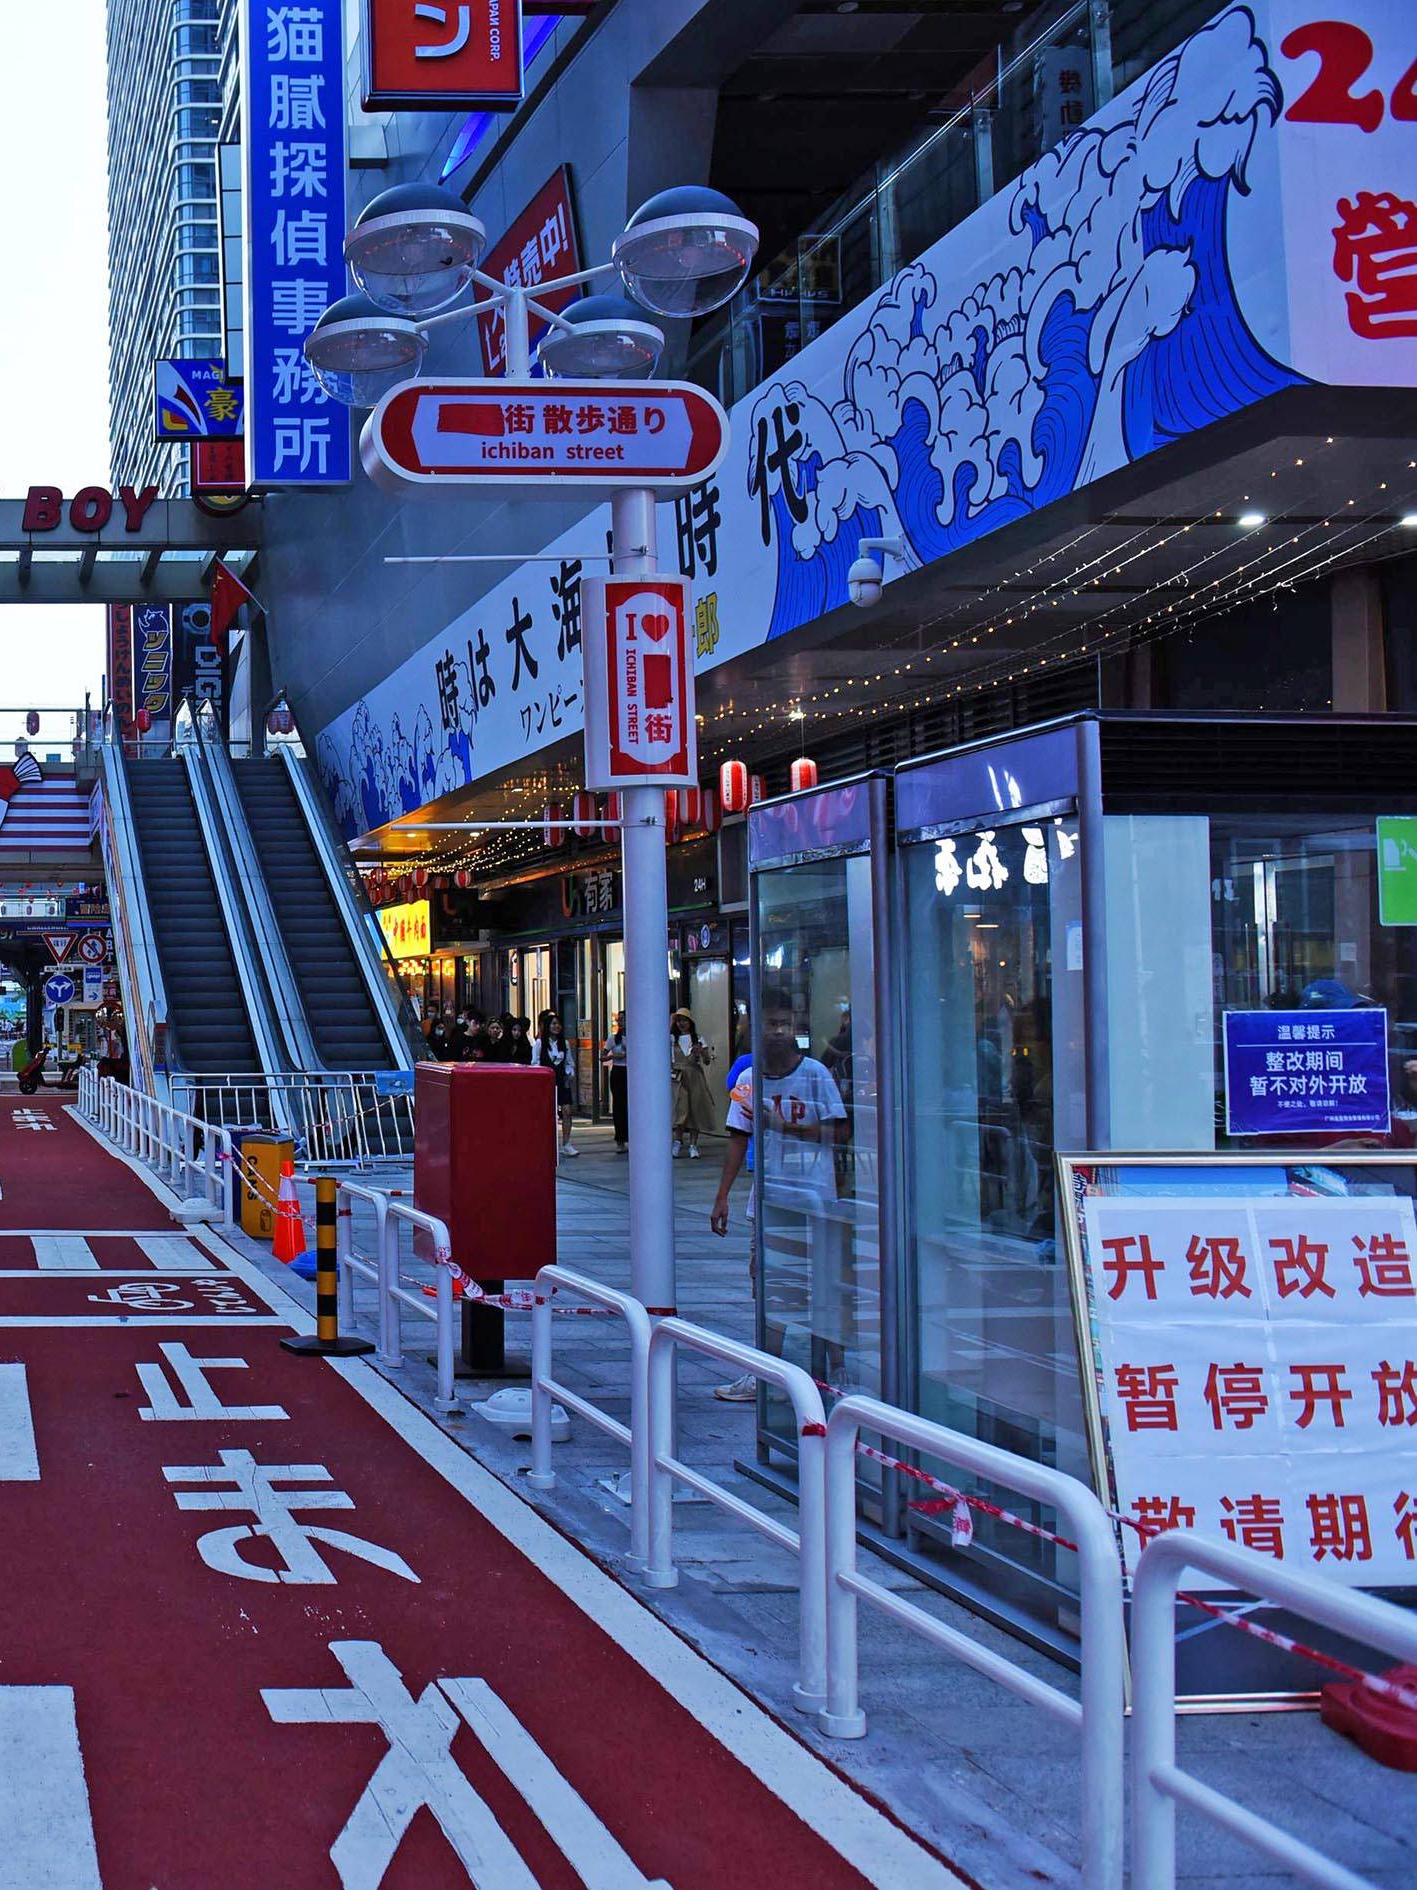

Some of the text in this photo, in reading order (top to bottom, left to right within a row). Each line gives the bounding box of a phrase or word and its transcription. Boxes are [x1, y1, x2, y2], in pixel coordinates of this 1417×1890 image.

[490, 28, 500, 61] CORP.
[1282, 21, 1417, 132] 2
[204, 387, 239, 421] 豪
[543, 404, 666, 435] 散歩通り
[482, 442, 624, 461] ichiban street
[22, 486, 160, 532] BOY
[434, 403, 809, 731] 時は大海時代
[625, 613, 636, 641] I
[519, 683, 585, 742] ワンピー
[626, 649, 639, 745] ICHIBAN STREET
[644, 713, 673, 744] 街
[694, 877, 707, 892] 24H
[1278, 1024, 1335, 1041] 温馨提示
[1266, 1051, 1343, 1073] 整改期间
[1249, 1074, 1367, 1097] 暂不对外开放
[1102, 1232, 1417, 1301] 升级改造
[1114, 1360, 1417, 1432] 暂停开放
